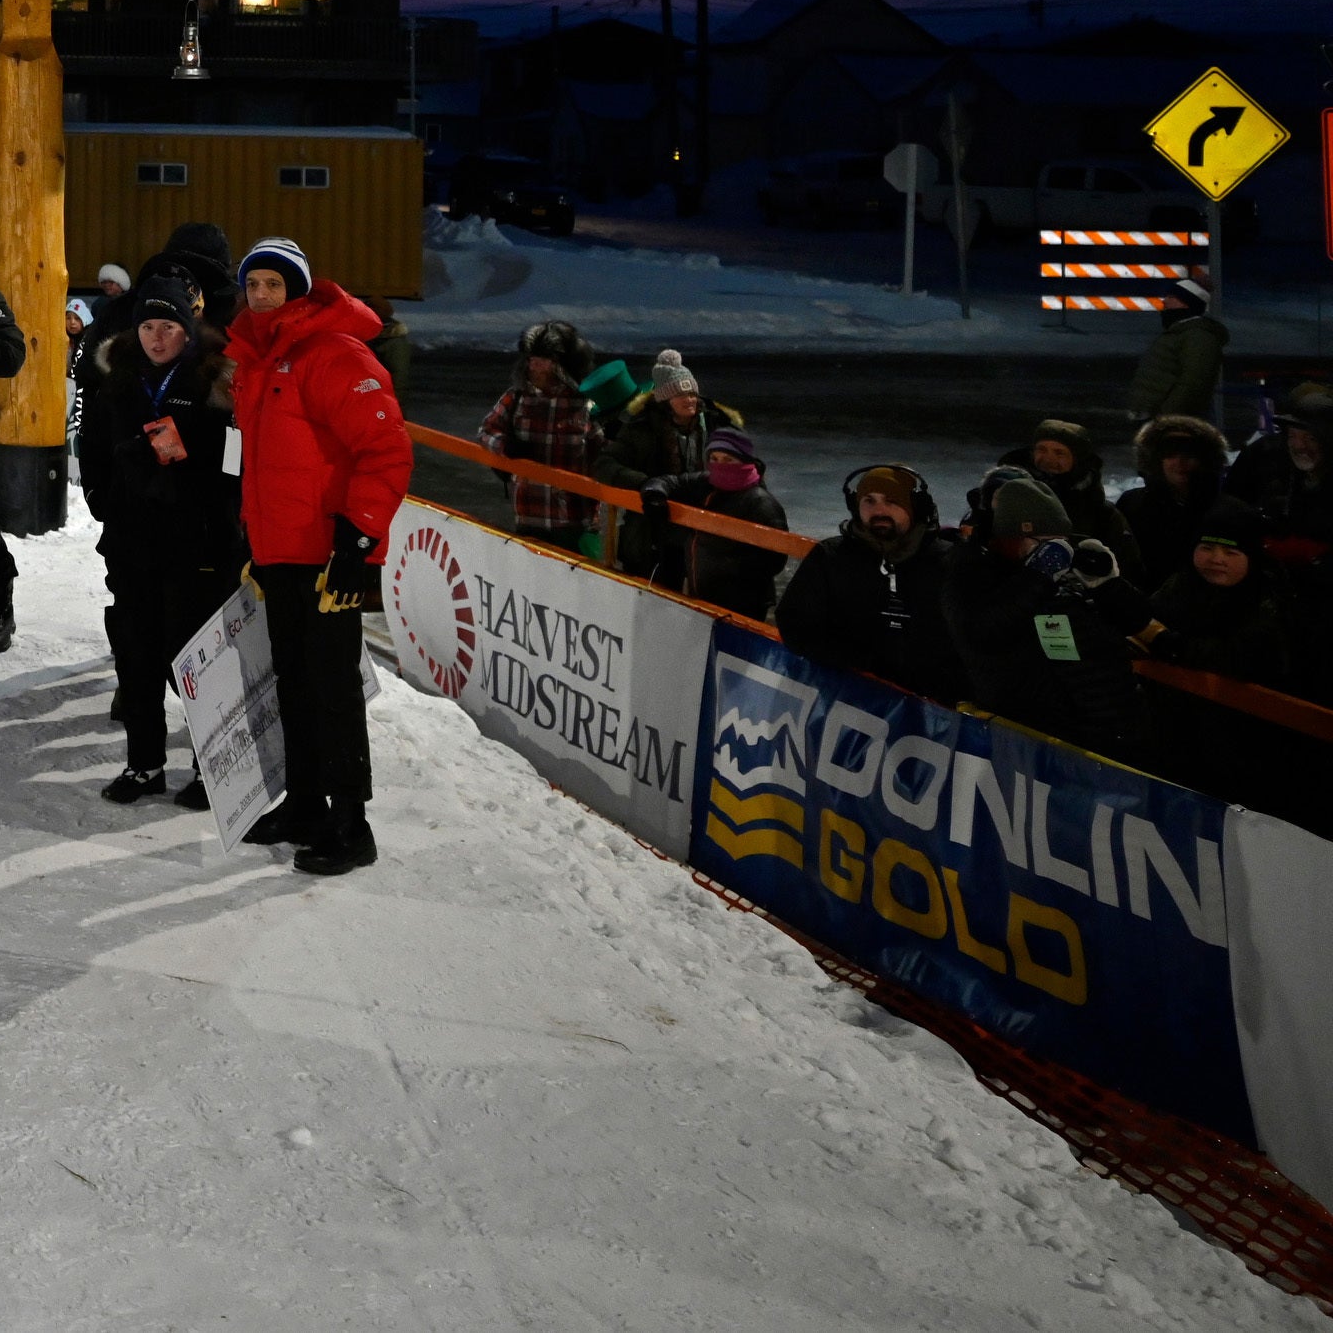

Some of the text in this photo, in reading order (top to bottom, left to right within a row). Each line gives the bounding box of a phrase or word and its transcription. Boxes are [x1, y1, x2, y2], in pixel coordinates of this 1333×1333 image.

[474, 573, 624, 693] HARVEST
[480, 640, 687, 804] MIDSTREAM
[815, 699, 1229, 949] DONLIN
[819, 806, 1087, 1006] GOLD
